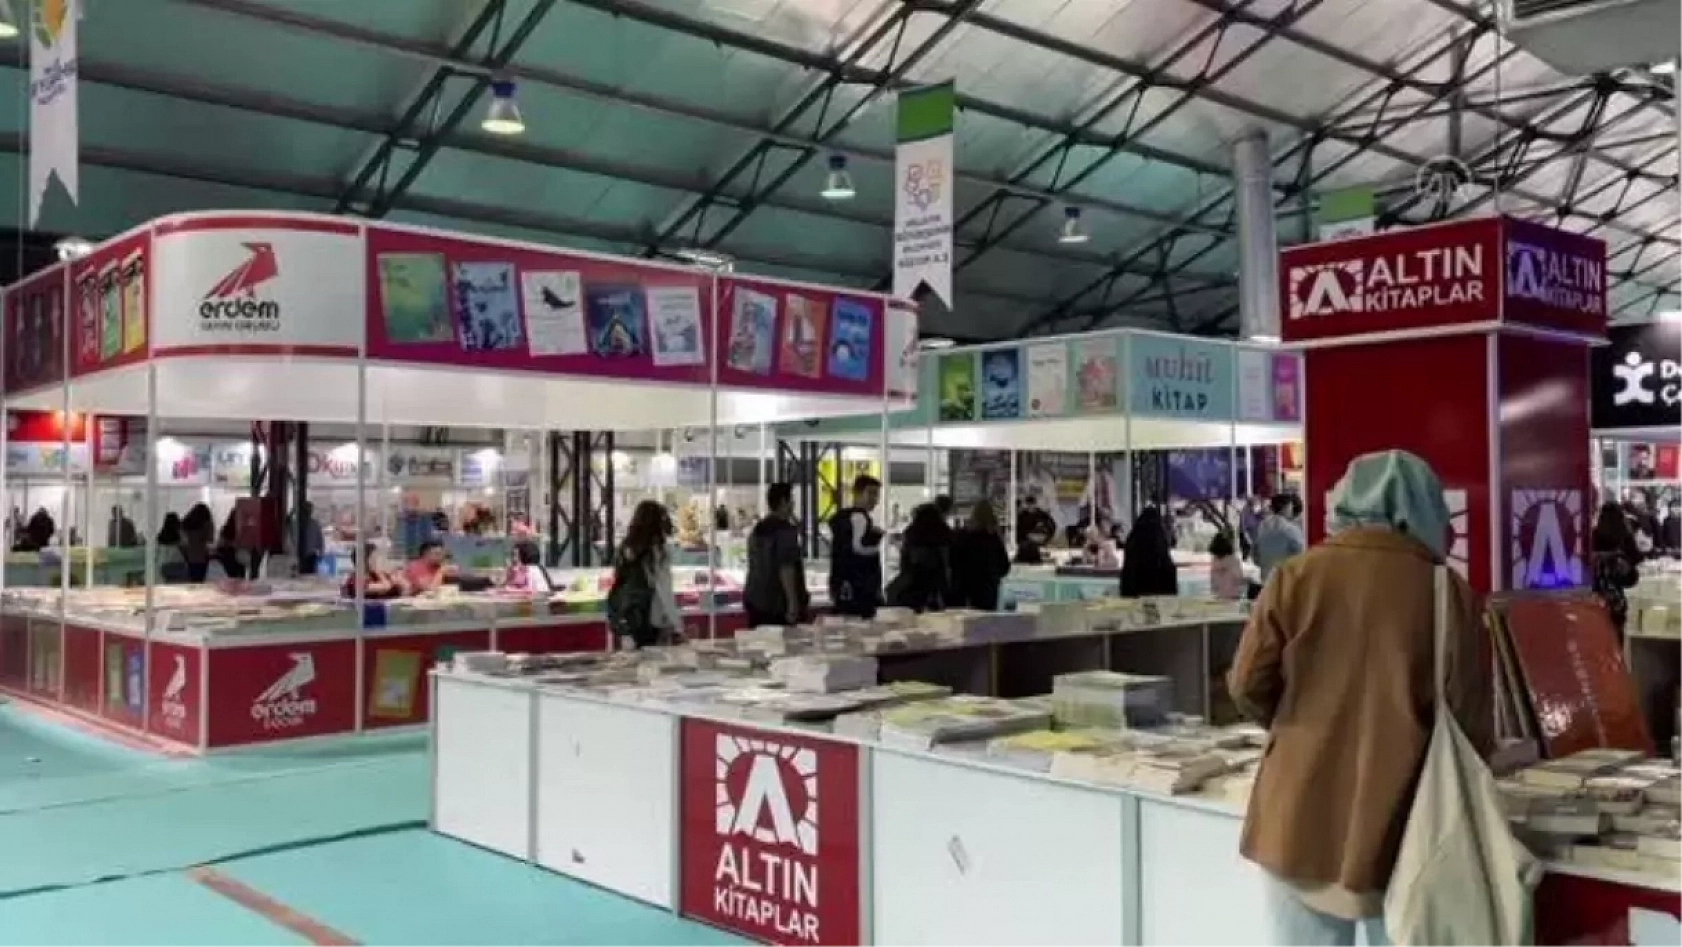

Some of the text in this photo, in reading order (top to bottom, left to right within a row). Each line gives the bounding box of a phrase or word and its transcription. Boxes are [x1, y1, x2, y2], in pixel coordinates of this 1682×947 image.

[1367, 243, 1483, 288] ALTIN
[1547, 251, 1601, 293] ALTIN
[199, 298, 279, 319] erdem
[1365, 280, 1484, 313] KİTAPLAR
[1152, 384, 1208, 411] KİTAP
[715, 842, 818, 908] ALTIN
[714, 884, 819, 943] KİTAPLAR
